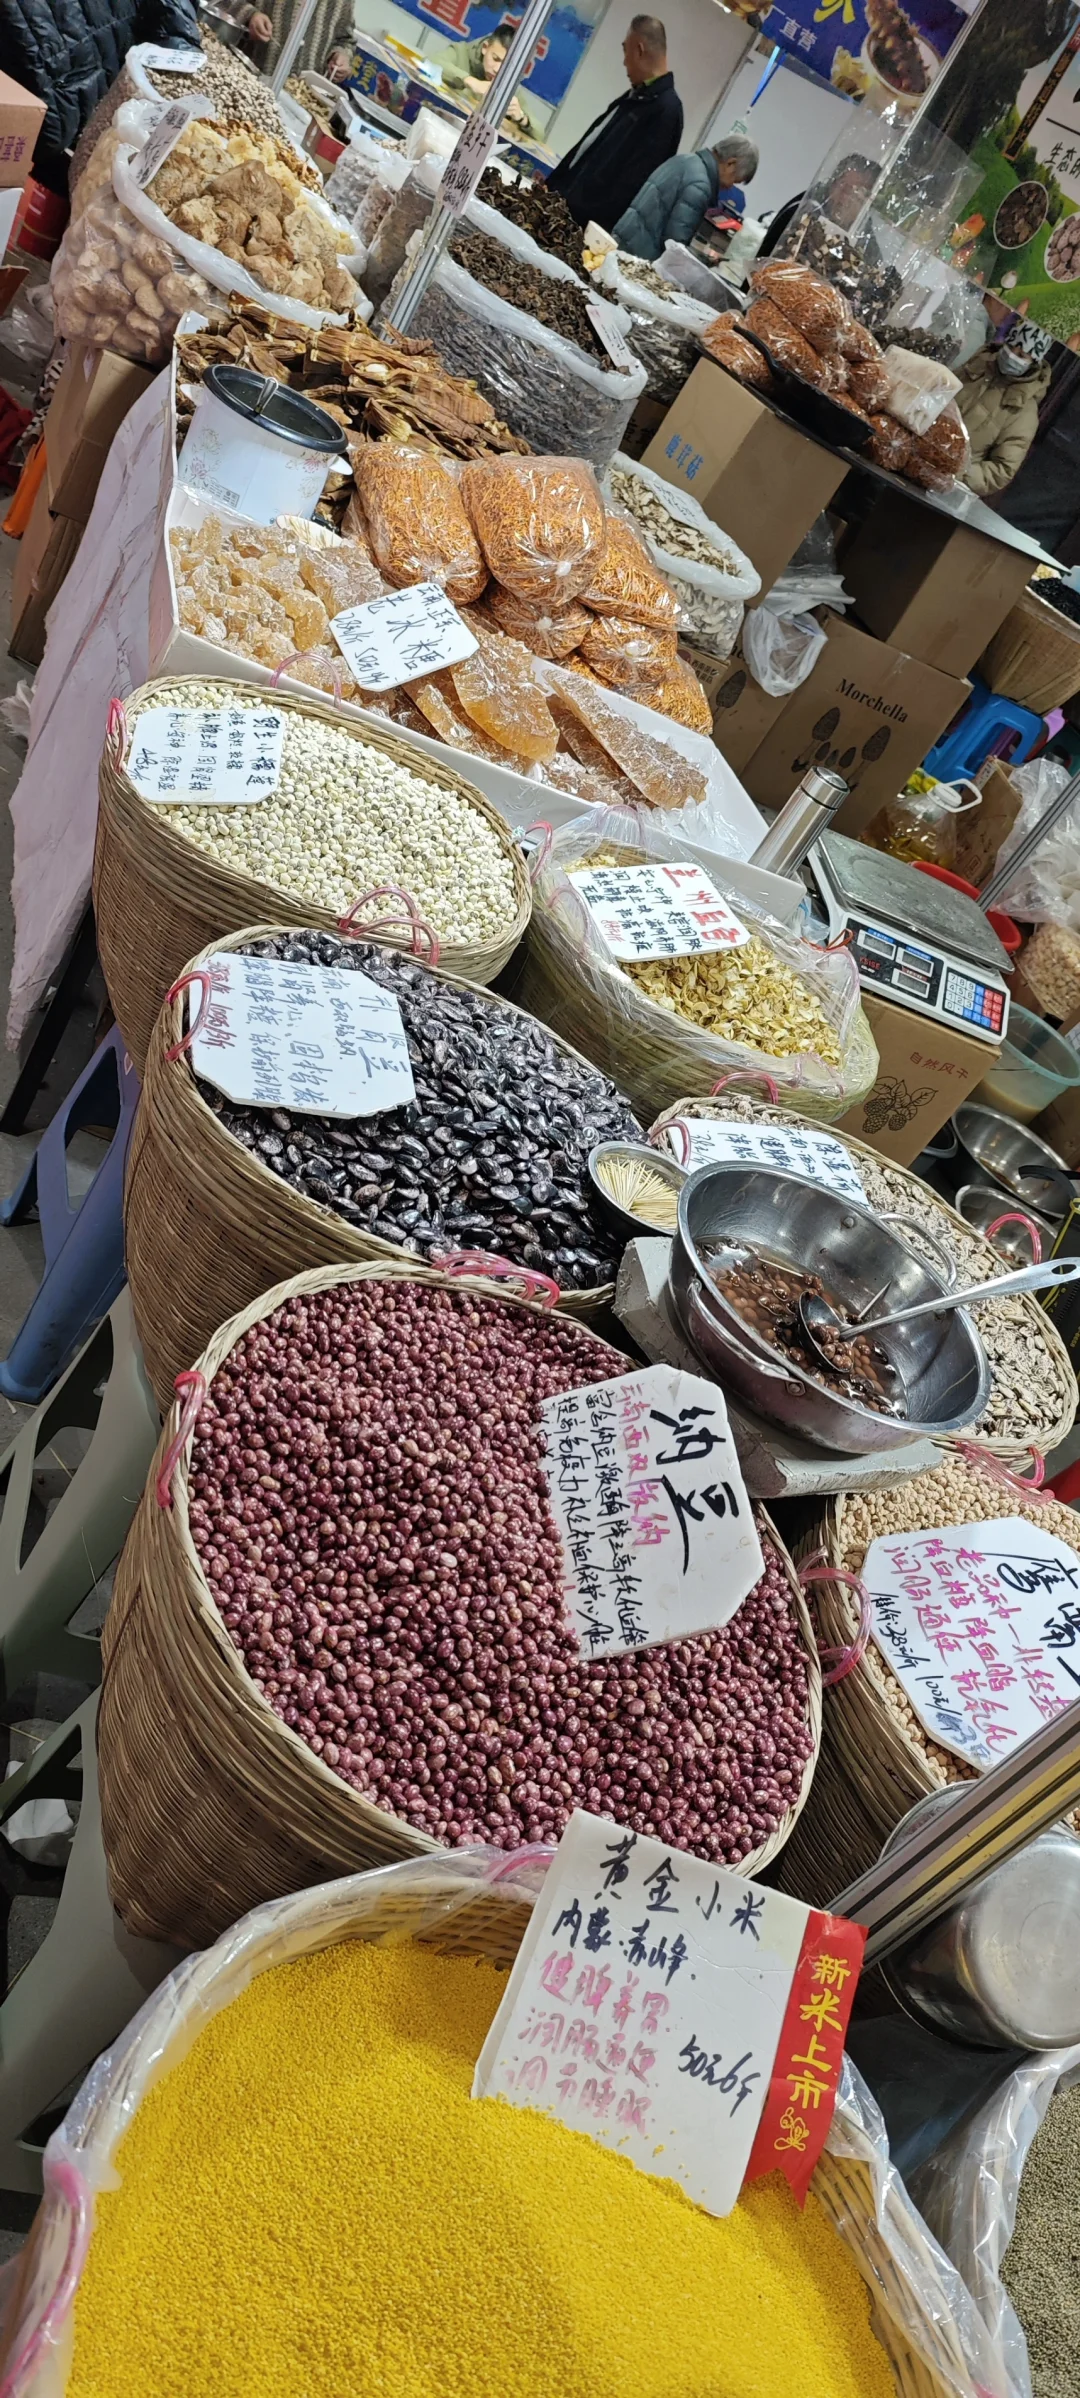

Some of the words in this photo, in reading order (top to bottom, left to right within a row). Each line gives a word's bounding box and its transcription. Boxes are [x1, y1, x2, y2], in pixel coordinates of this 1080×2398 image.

[368, 593, 445, 671] 老冰糖
[835, 677, 908, 724] Morchella
[662, 866, 741, 945] 兰州百合
[910, 1052, 969, 1079] 自然风干
[650, 1409, 740, 1576] 纳豆
[884, 1546, 970, 1666] 润肠通便
[952, 1668, 1018, 1755] 抗氧化
[913, 1538, 978, 1609] 降血糖
[958, 1617, 1018, 1693] 降血脂
[594, 1833, 766, 1941] 黄金小米
[788, 1954, 853, 2109] 新米上市
